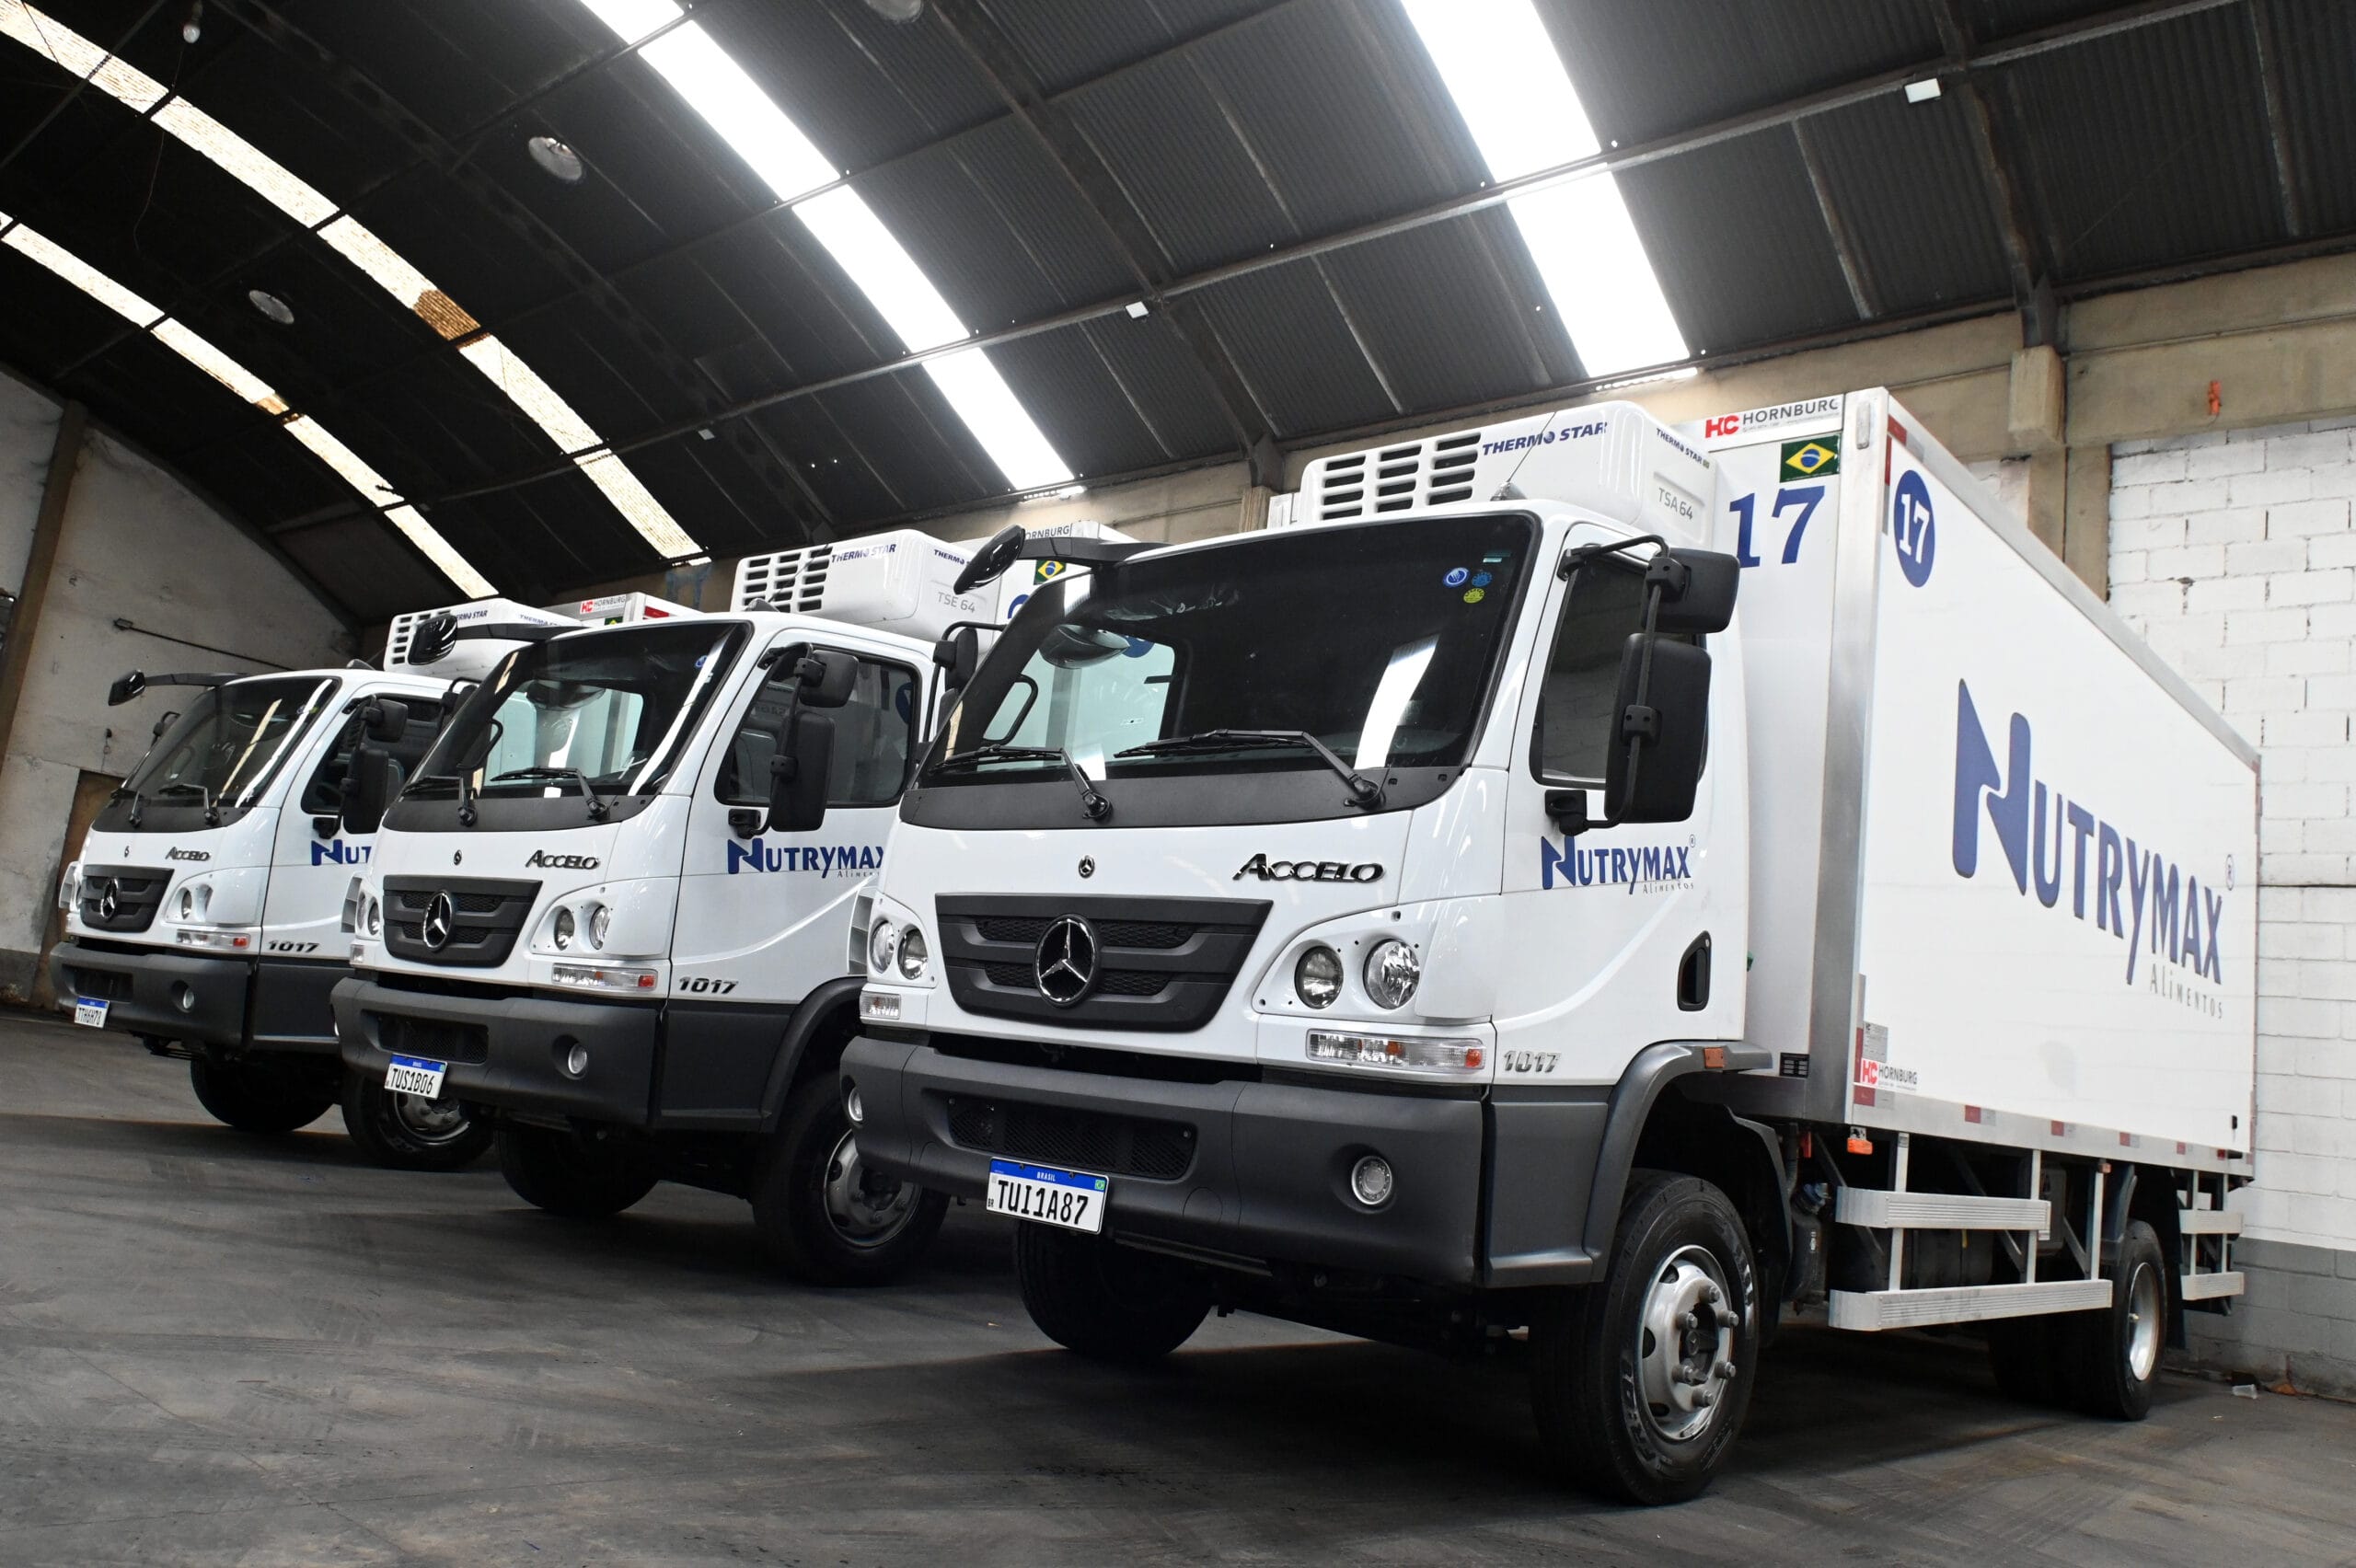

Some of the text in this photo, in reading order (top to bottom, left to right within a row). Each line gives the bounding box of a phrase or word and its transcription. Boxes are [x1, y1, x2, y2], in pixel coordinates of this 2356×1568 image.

[1483, 421, 1607, 455] THERMO STAR
[1705, 415, 1739, 439] HC
[1657, 427, 1684, 453] THERMO
[1686, 447, 1703, 464] STAR
[1658, 488, 1693, 520] TSA 64
[1729, 486, 1826, 569] 17
[1899, 493, 1930, 564] 17
[831, 544, 896, 563] THERMO STAR
[933, 549, 965, 565] THERMO
[472, 609, 489, 619] STAR
[938, 591, 976, 614] TSE 64
[1952, 677, 2223, 986] NUTRYMAX
[165, 846, 211, 862] ACCELO
[525, 849, 601, 870] ACCELO
[1541, 834, 1692, 895] NUTRYMAX
[1231, 853, 1386, 883] ACCELO
[268, 939, 320, 953] 1017
[679, 975, 739, 995] 1017
[1502, 1049, 1562, 1074] 1017
[1862, 1059, 1918, 1085] HC HORNBURG
[390, 1067, 435, 1095] TUS1B06
[1036, 1170, 1056, 1182] BRASIL
[998, 1179, 1090, 1226] TUI1A87
